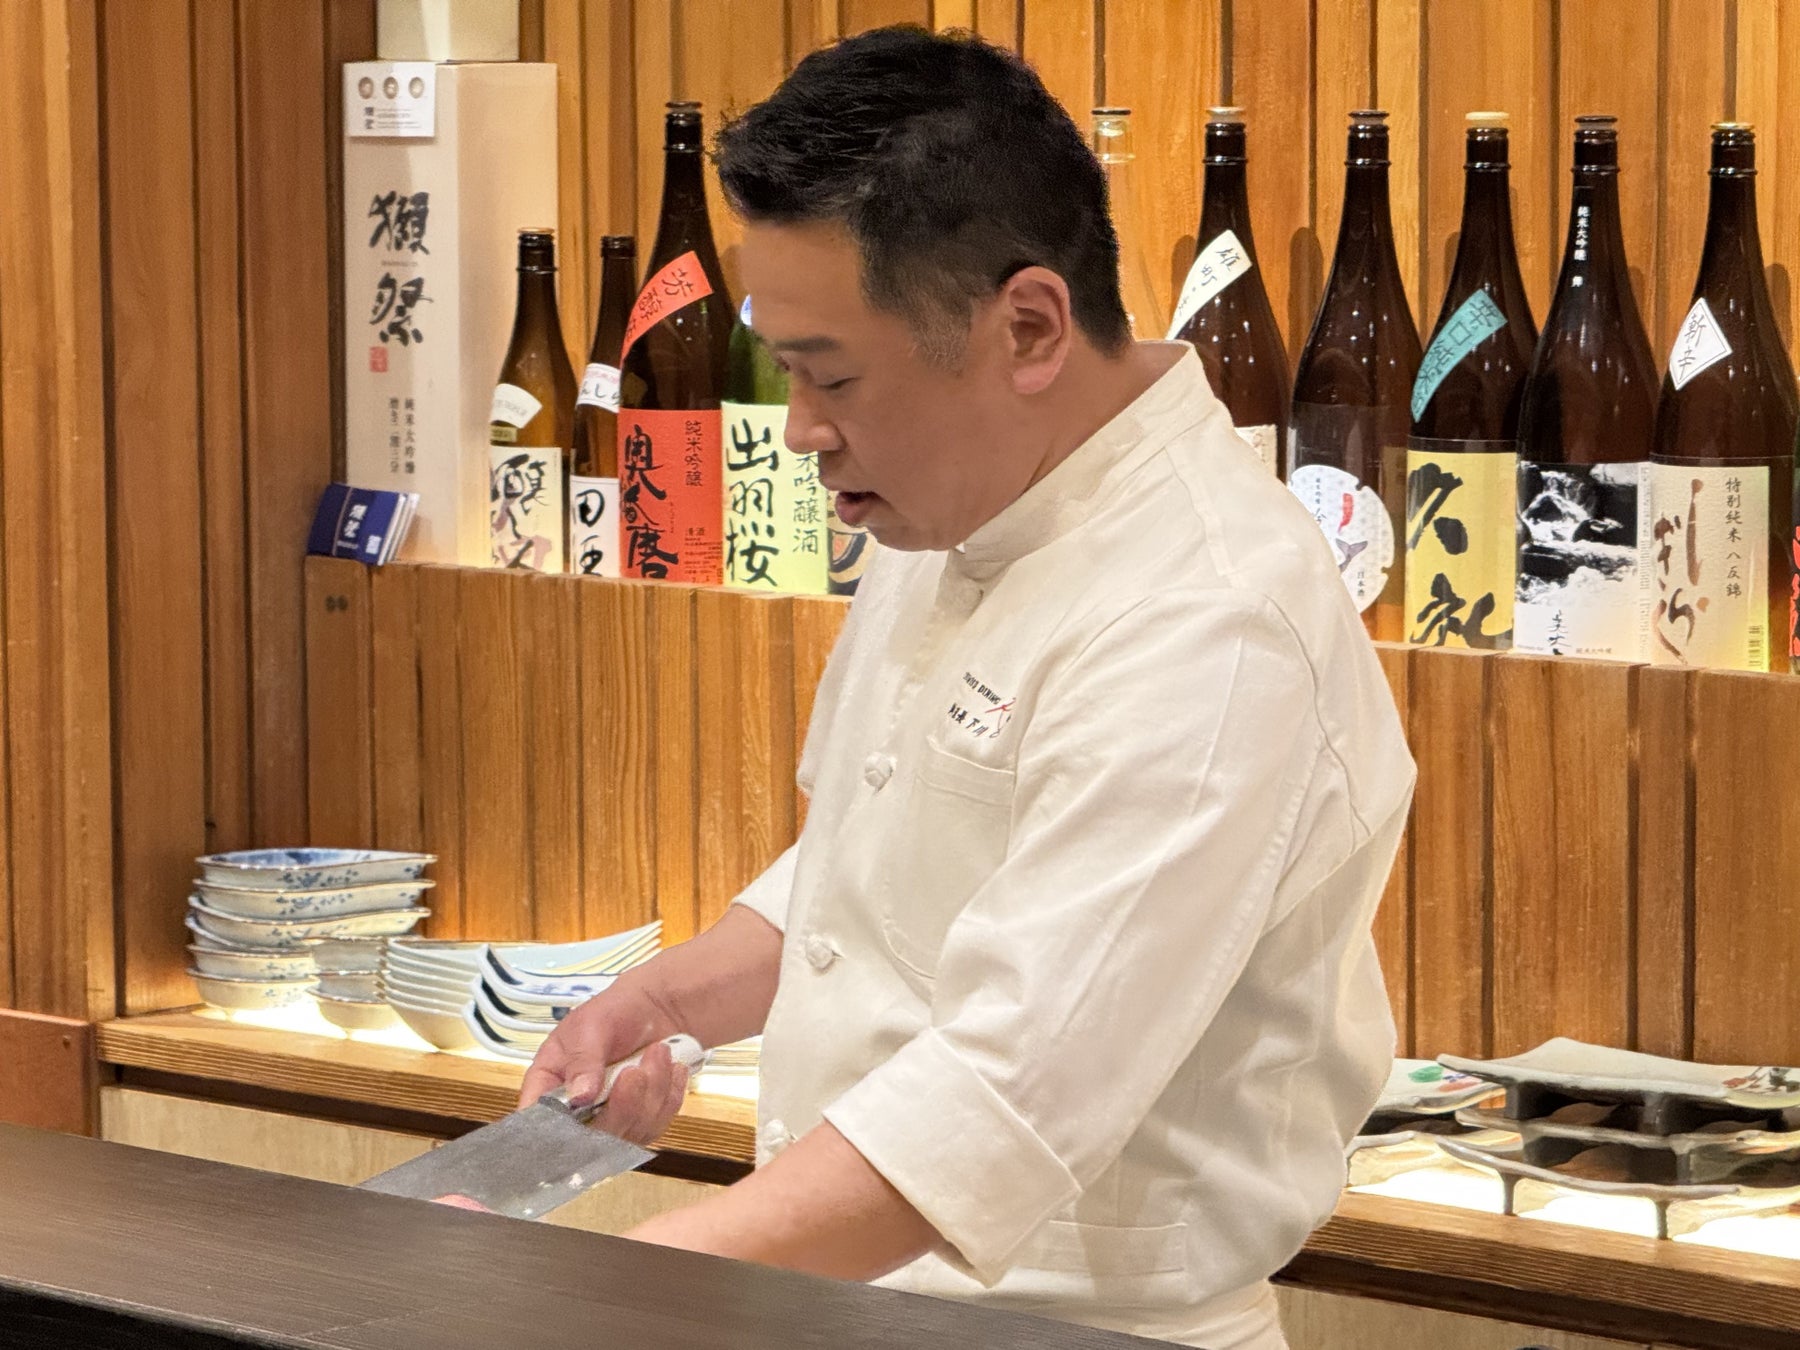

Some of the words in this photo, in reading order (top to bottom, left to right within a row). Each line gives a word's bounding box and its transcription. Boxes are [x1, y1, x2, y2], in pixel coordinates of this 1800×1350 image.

[368, 190, 434, 347] 獺祭
[622, 424, 680, 580] 奥播磨
[685, 420, 703, 487] 純米吟醸
[726, 418, 780, 587] 出羽桜
[1407, 462, 1514, 649] 久礼
[1725, 477, 1743, 542] 特別純米
[1726, 551, 1742, 599] 八反錦
[1547, 609, 1572, 655] 美丈
